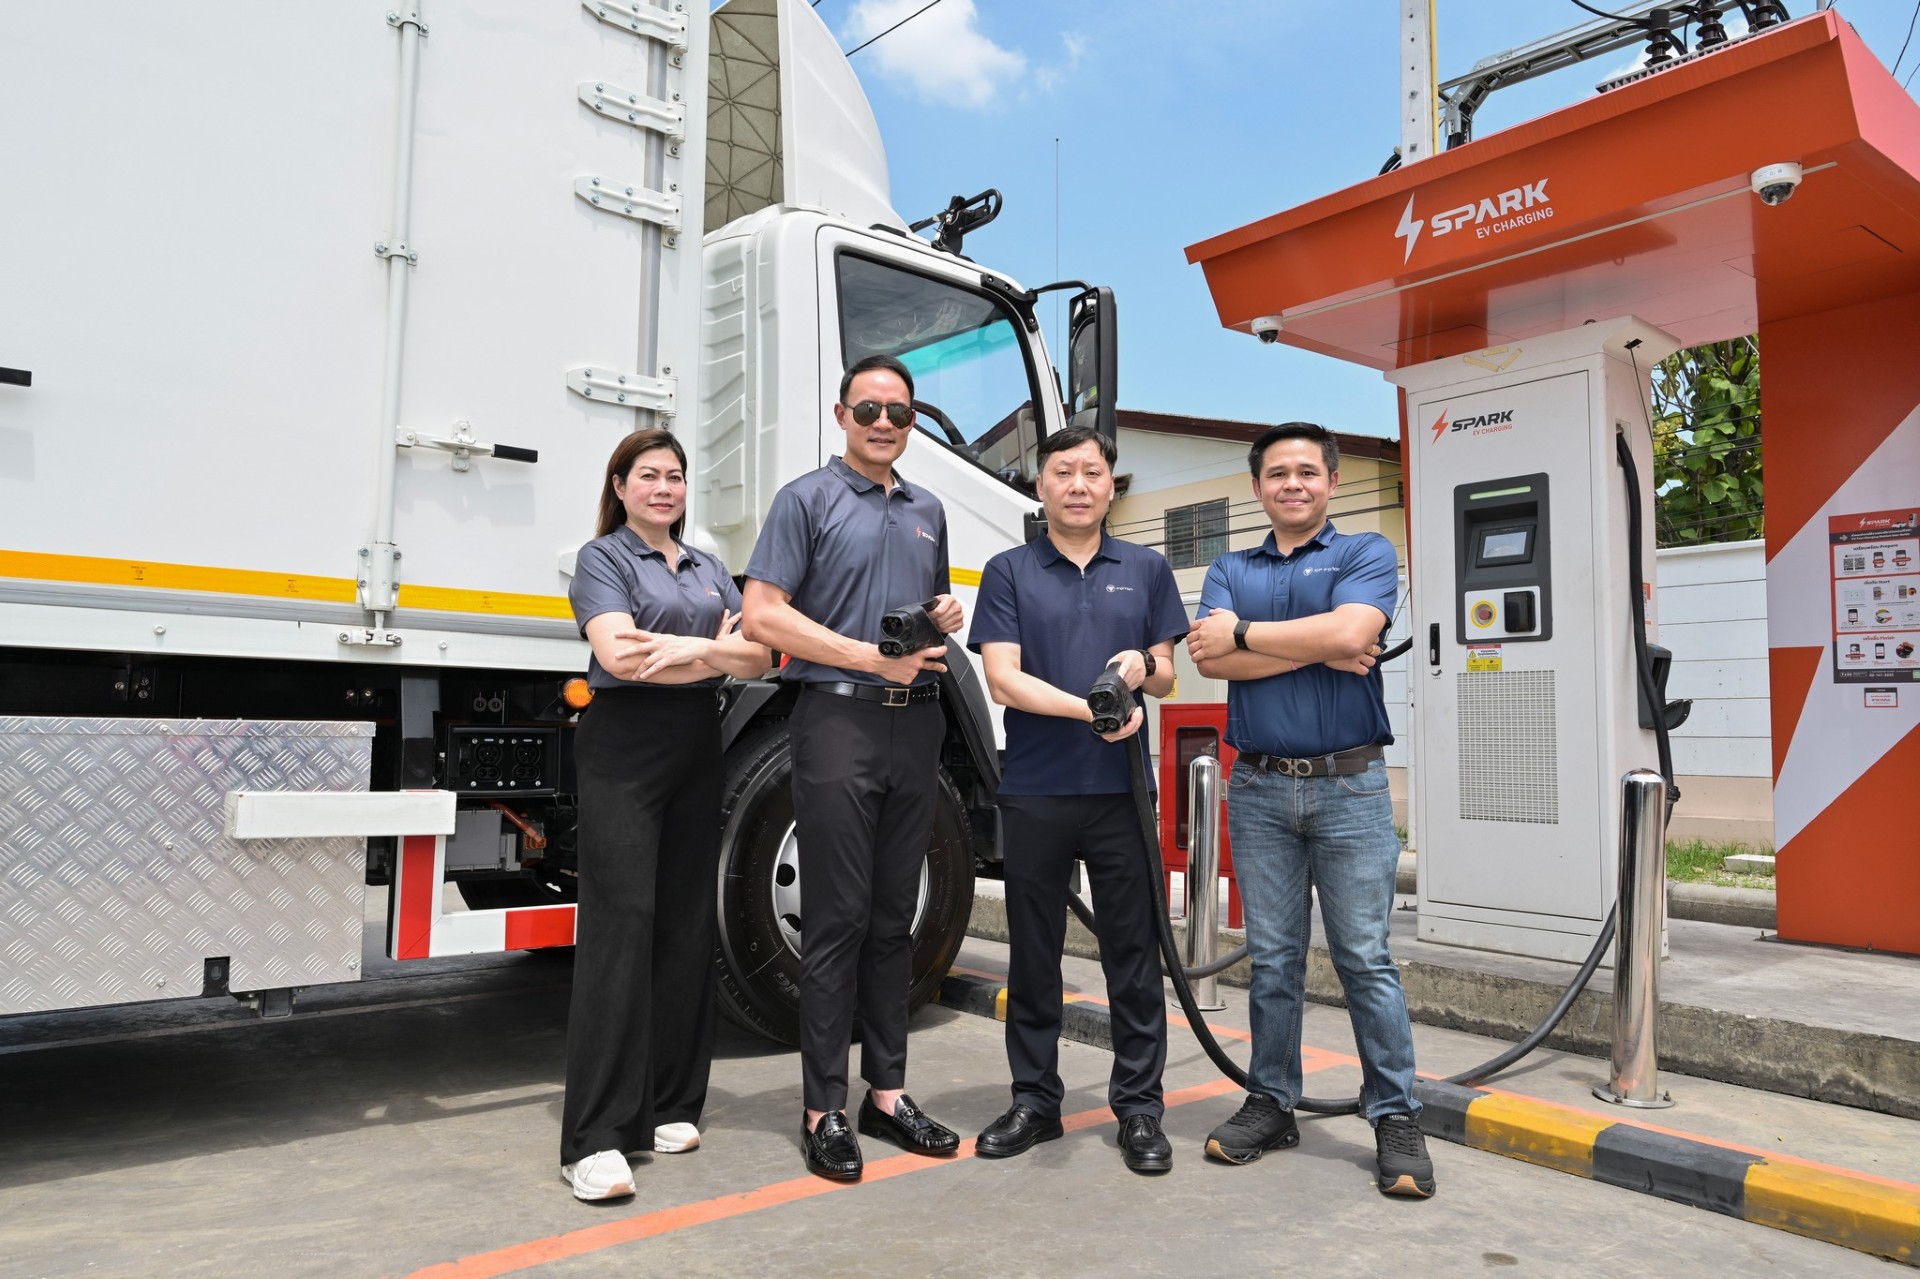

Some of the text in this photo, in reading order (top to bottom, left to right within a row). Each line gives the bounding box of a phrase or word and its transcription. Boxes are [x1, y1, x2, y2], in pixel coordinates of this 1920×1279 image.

[1431, 178, 1550, 237] SPARK
[1476, 207, 1554, 239] EV CHARGING
[1451, 409, 1514, 432] SPARK
[1481, 424, 1513, 435] CHARGING
